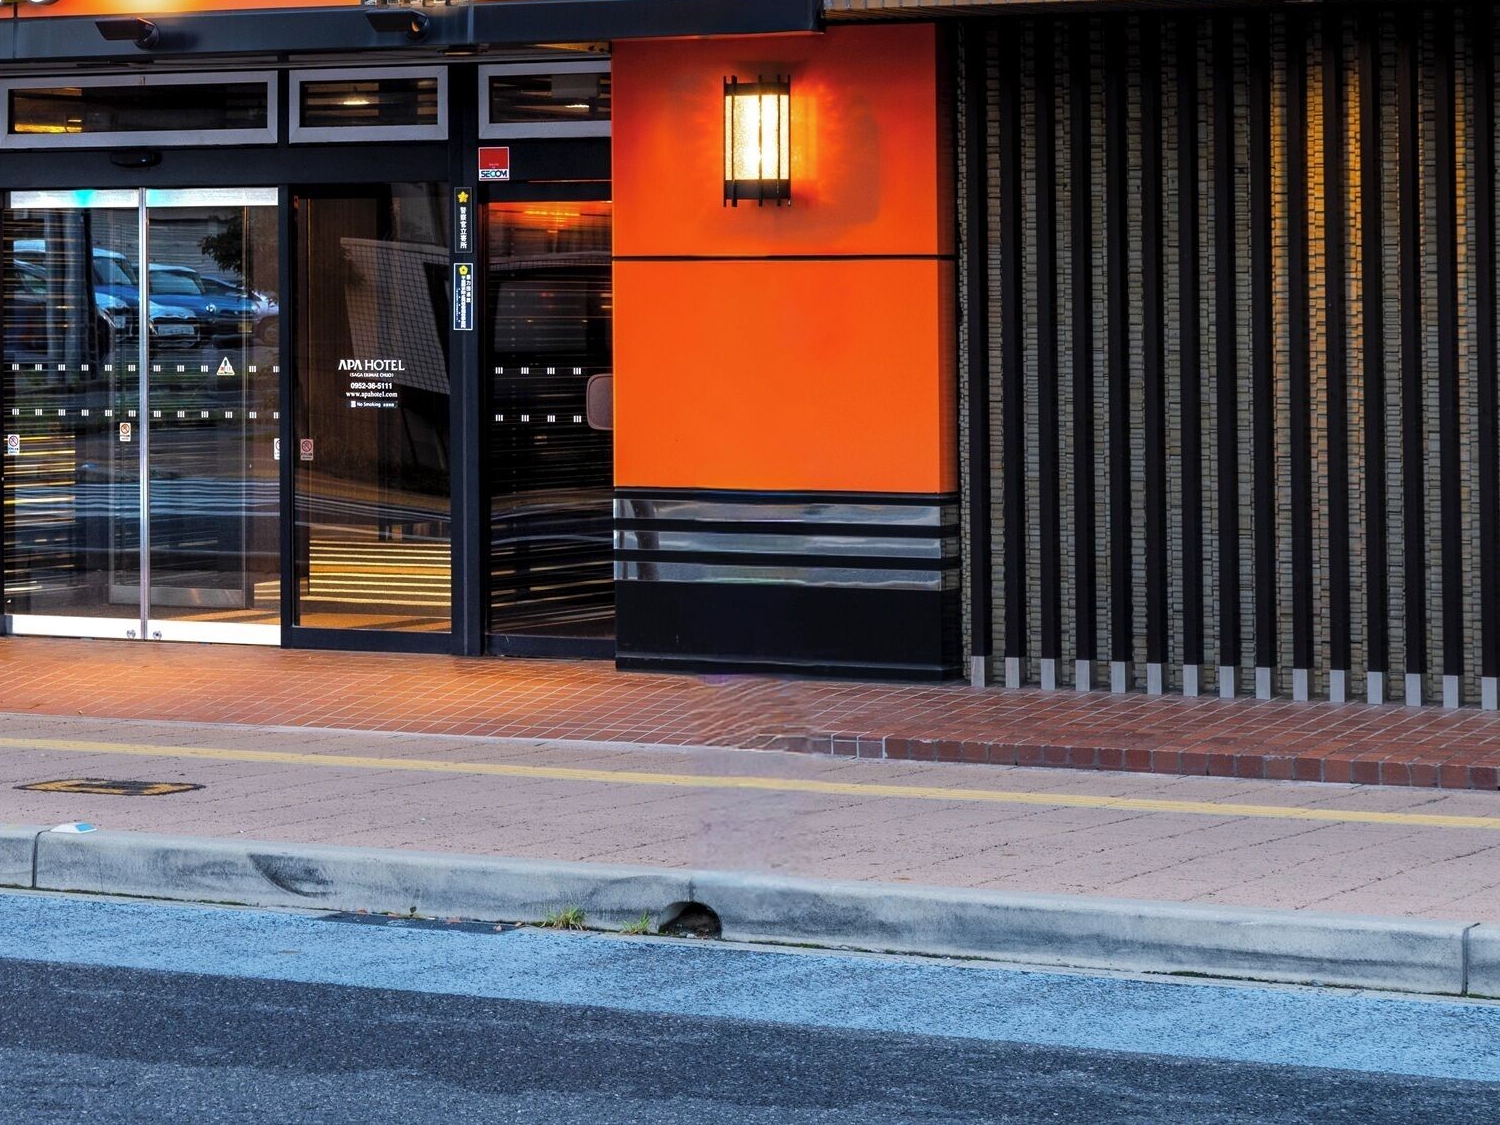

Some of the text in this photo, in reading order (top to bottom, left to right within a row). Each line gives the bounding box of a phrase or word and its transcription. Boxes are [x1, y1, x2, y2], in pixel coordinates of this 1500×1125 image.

[480, 169, 508, 178] SECOM
[338, 359, 405, 371] APA HOTEL
[350, 382, 393, 390] 0952-36-5111
[345, 391, 398, 399] www.apahotel.com
